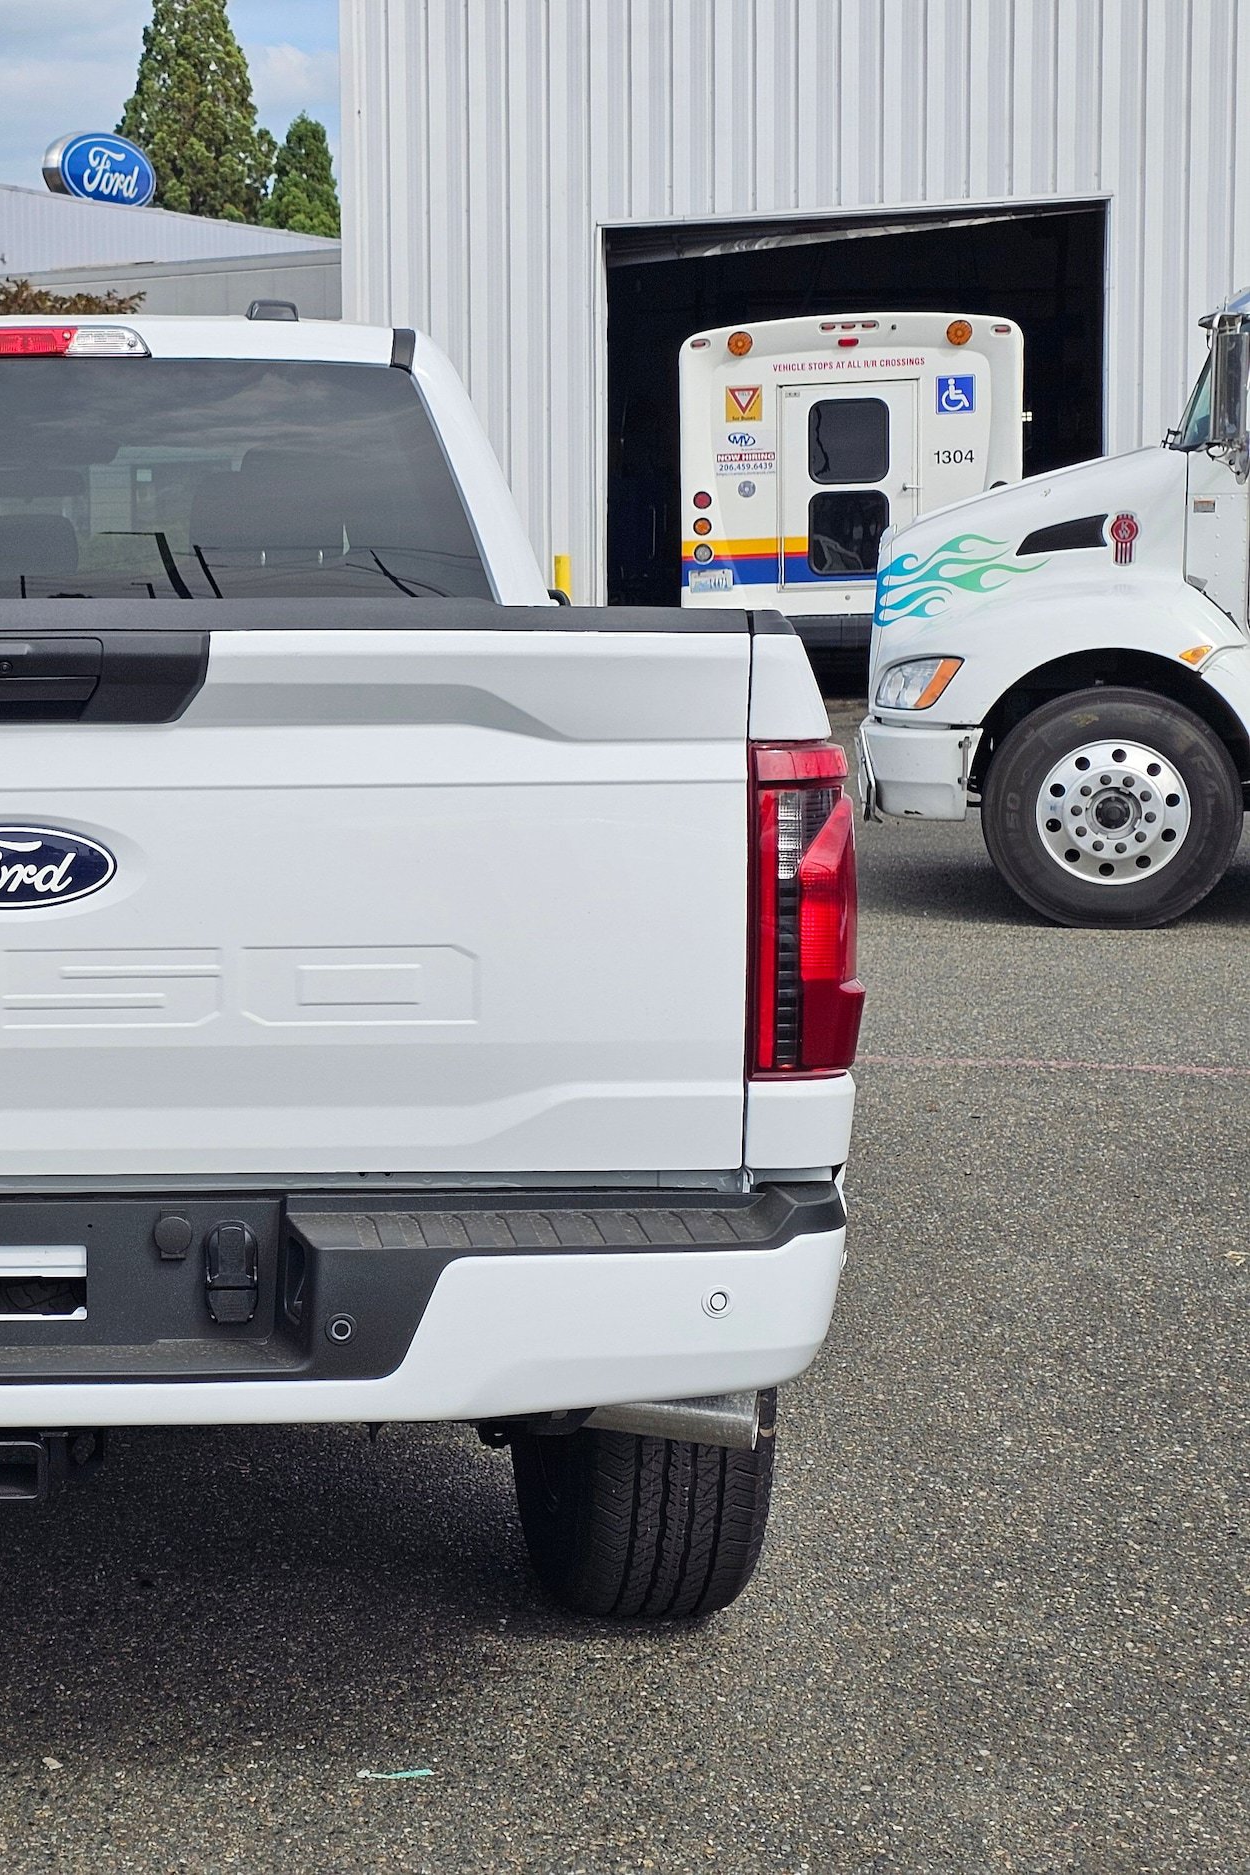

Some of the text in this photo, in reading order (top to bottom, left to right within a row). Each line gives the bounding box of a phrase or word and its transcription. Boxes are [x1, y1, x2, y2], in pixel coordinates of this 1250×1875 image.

[82, 146, 140, 199] Ford
[772, 362, 806, 372] VEHICLE
[808, 361, 834, 371] STOPS
[836, 360, 846, 369] AT
[847, 360, 861, 369] ALL
[879, 357, 926, 368] CROSSINGS
[717, 452, 775, 463] NOW HIRING
[933, 449, 975, 465] 1304
[719, 462, 773, 472] 206.459.6439
